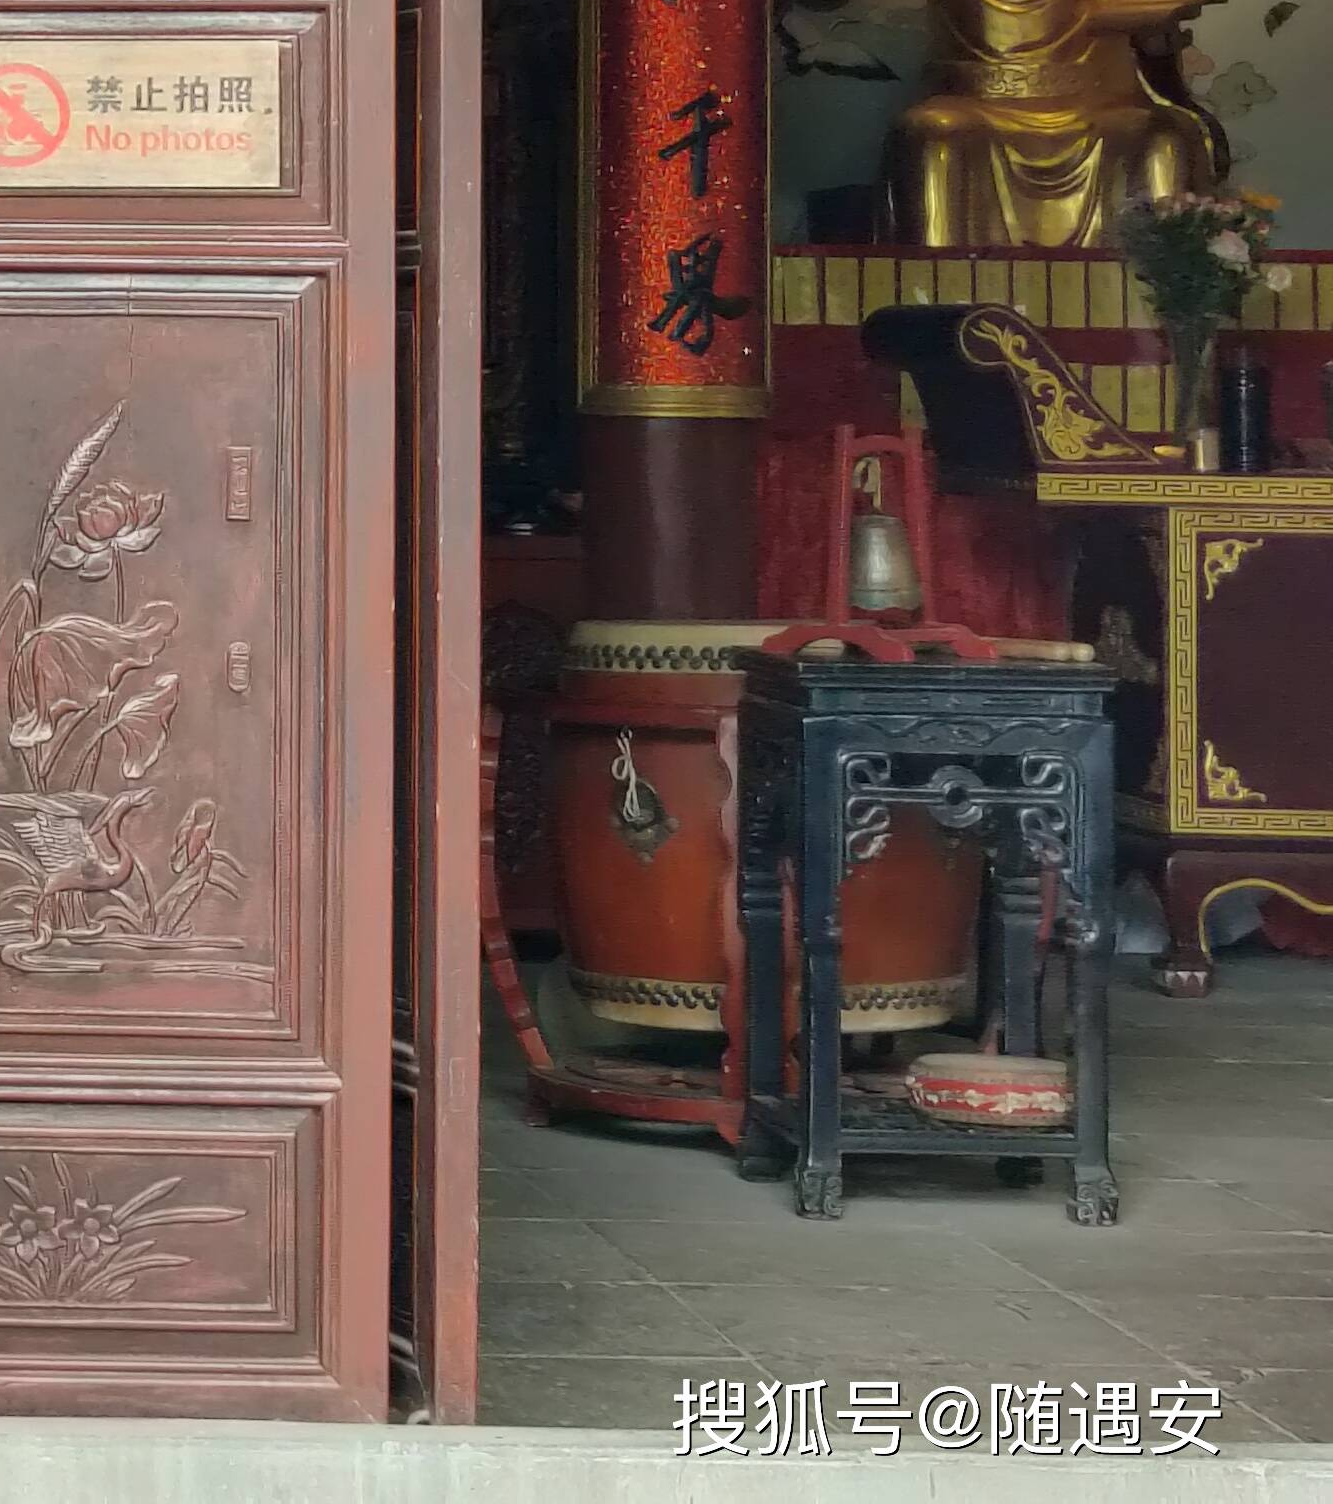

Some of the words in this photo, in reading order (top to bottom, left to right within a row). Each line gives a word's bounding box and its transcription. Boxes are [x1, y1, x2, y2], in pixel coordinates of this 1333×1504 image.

[86, 75, 254, 114] 禁止拍照
[85, 124, 132, 152] No
[141, 124, 253, 157] photos
